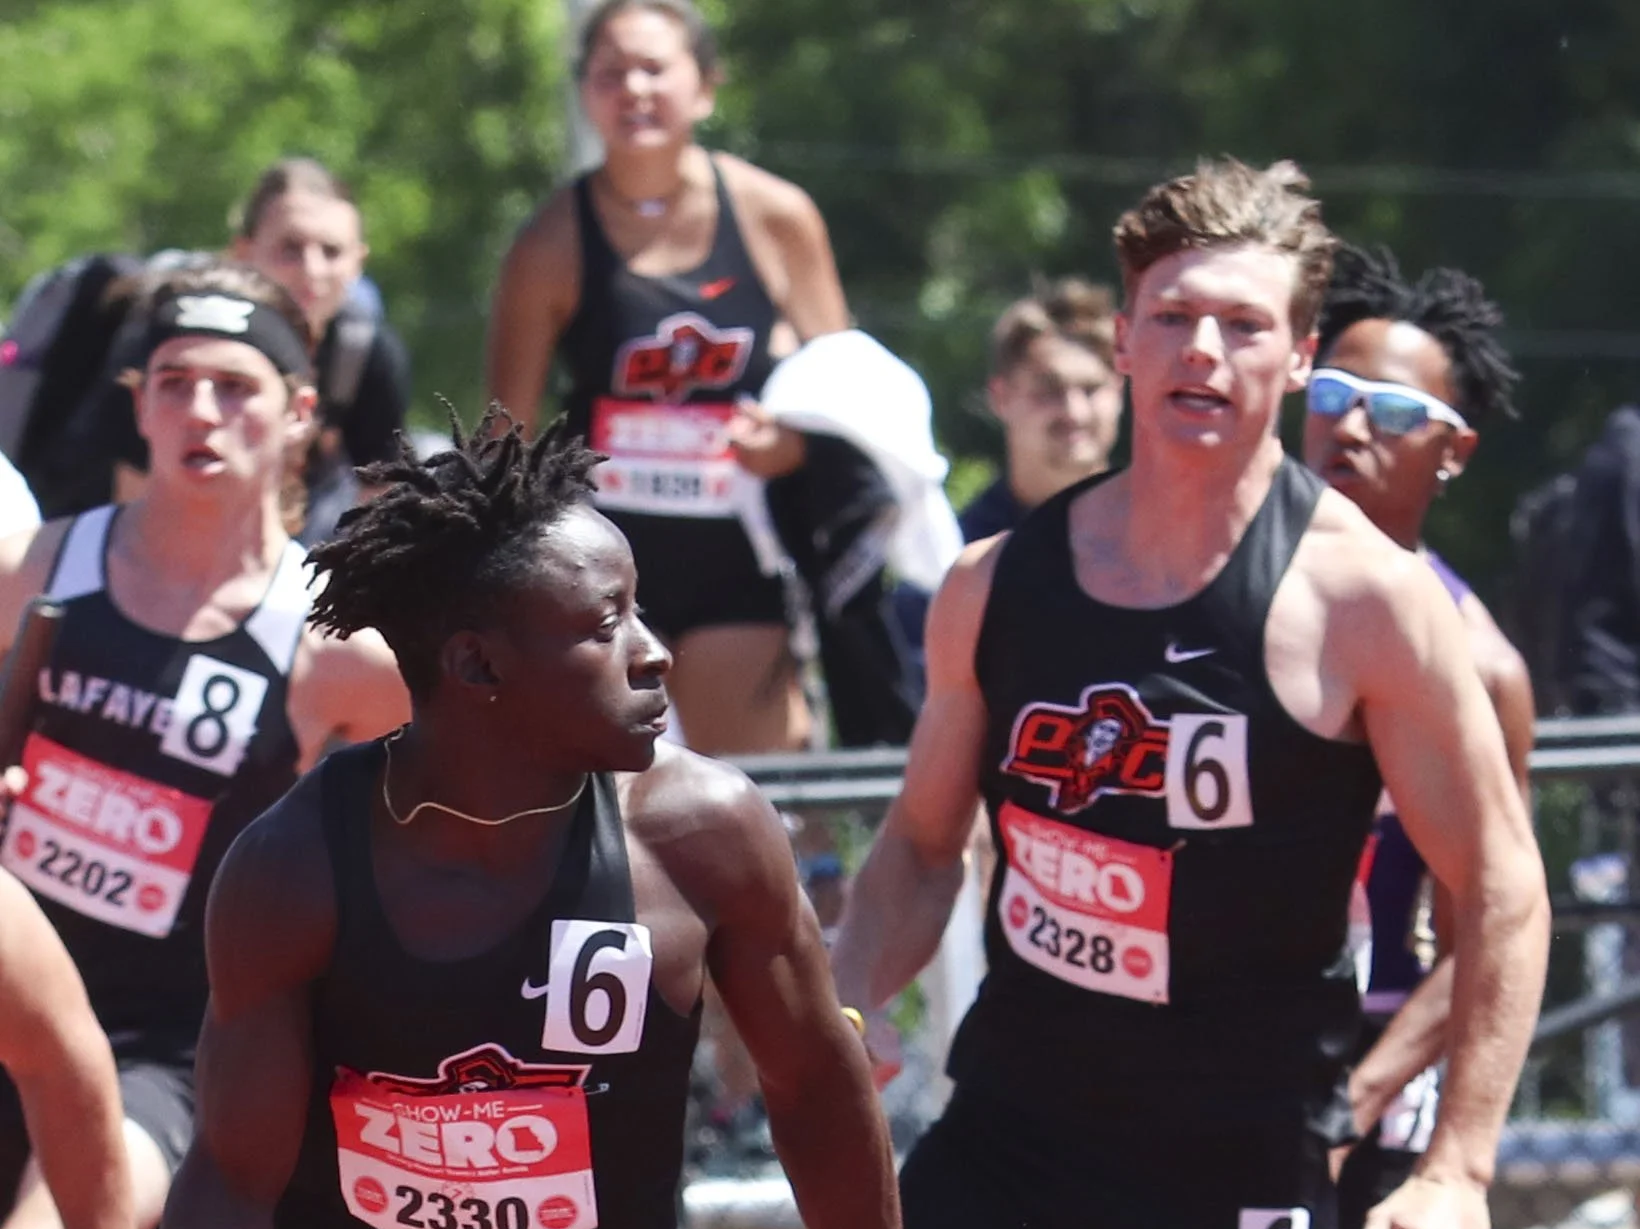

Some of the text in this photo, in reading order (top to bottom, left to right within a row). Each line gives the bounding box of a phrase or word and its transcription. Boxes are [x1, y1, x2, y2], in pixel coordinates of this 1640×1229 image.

[186, 674, 240, 758] 8
[32, 762, 183, 855] ZERO
[1184, 721, 1230, 821] 6
[39, 840, 133, 907] 2202
[1029, 906, 1115, 974] 2328
[569, 929, 627, 1047] 6
[354, 1103, 558, 1169] ZERO
